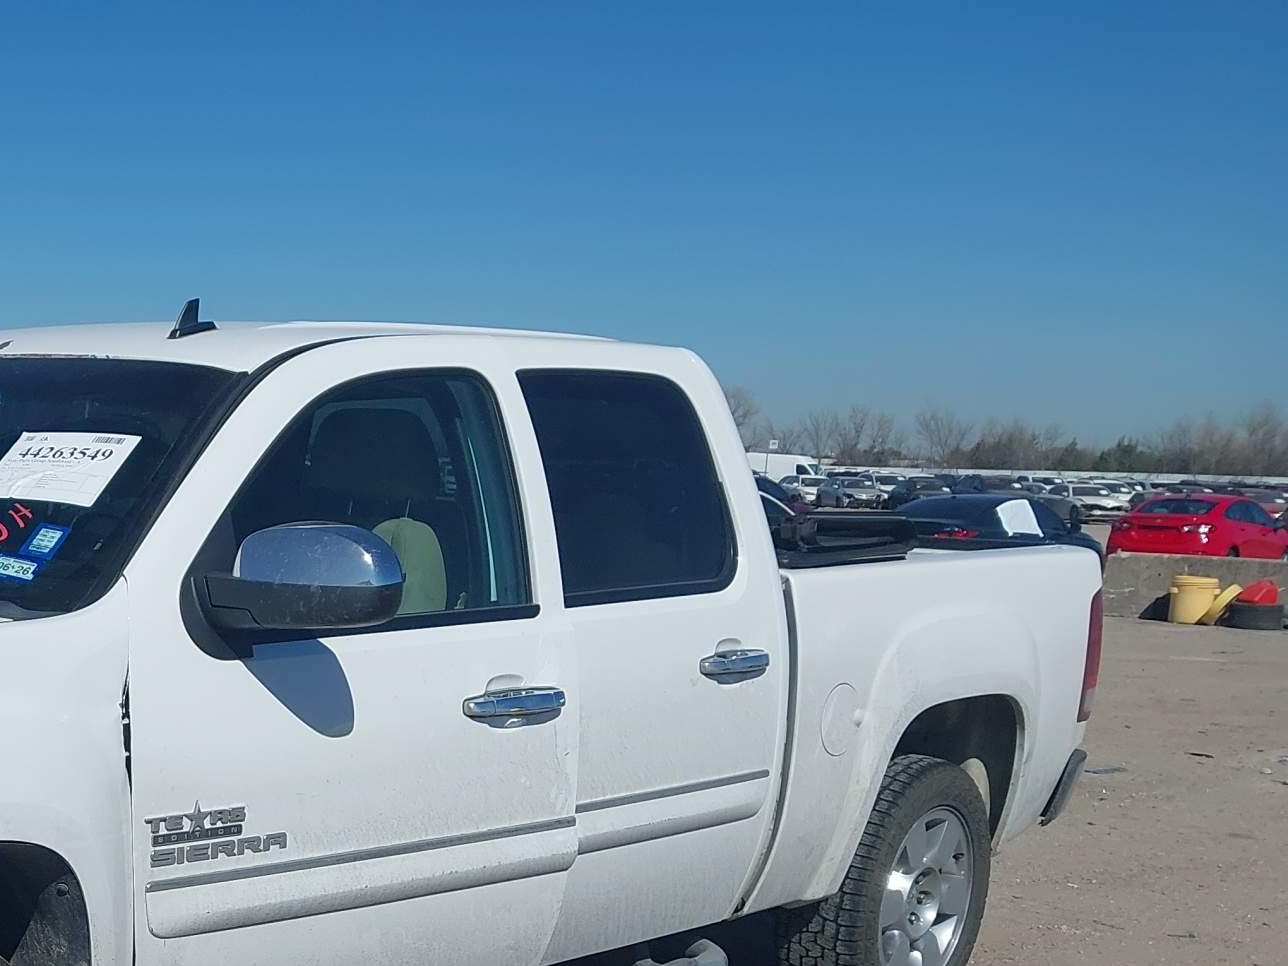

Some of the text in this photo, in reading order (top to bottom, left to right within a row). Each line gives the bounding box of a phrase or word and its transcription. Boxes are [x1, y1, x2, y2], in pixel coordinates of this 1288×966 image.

[19, 446, 114, 462] 44263549
[144, 801, 247, 835] TEXAS
[157, 826, 239, 844] EDITION
[150, 832, 288, 868] SIERRA
